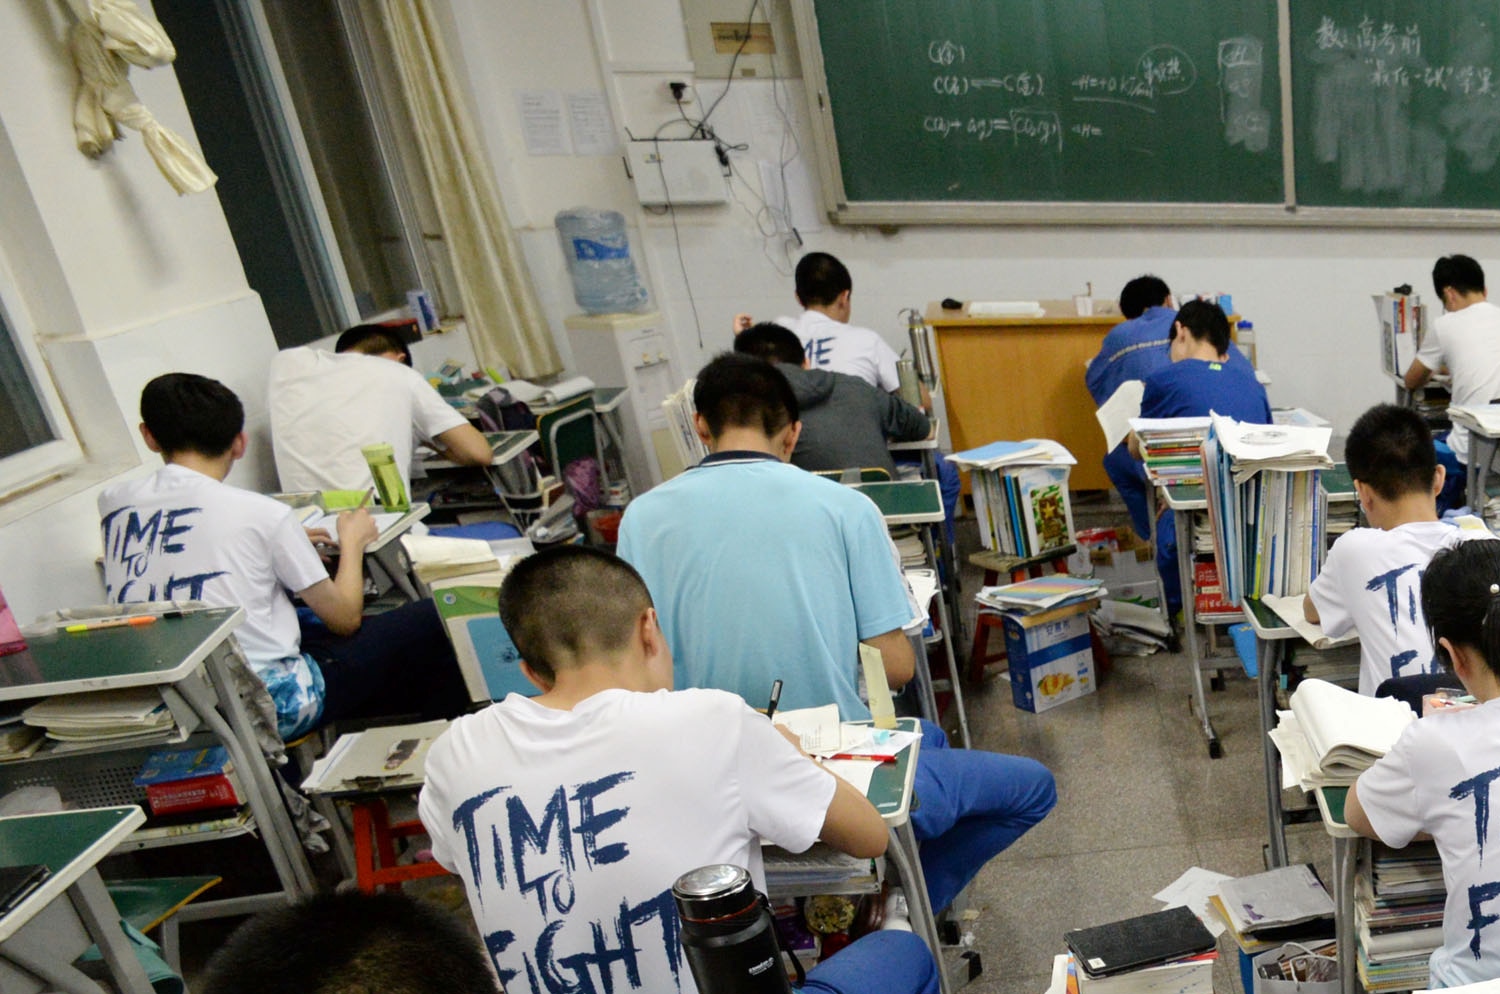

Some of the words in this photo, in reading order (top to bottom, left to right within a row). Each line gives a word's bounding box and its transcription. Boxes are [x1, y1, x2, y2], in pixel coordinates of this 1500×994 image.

[101, 506, 203, 563] TIME
[121, 551, 150, 577] TO
[452, 770, 636, 897] TIME
[527, 868, 576, 920] TO
